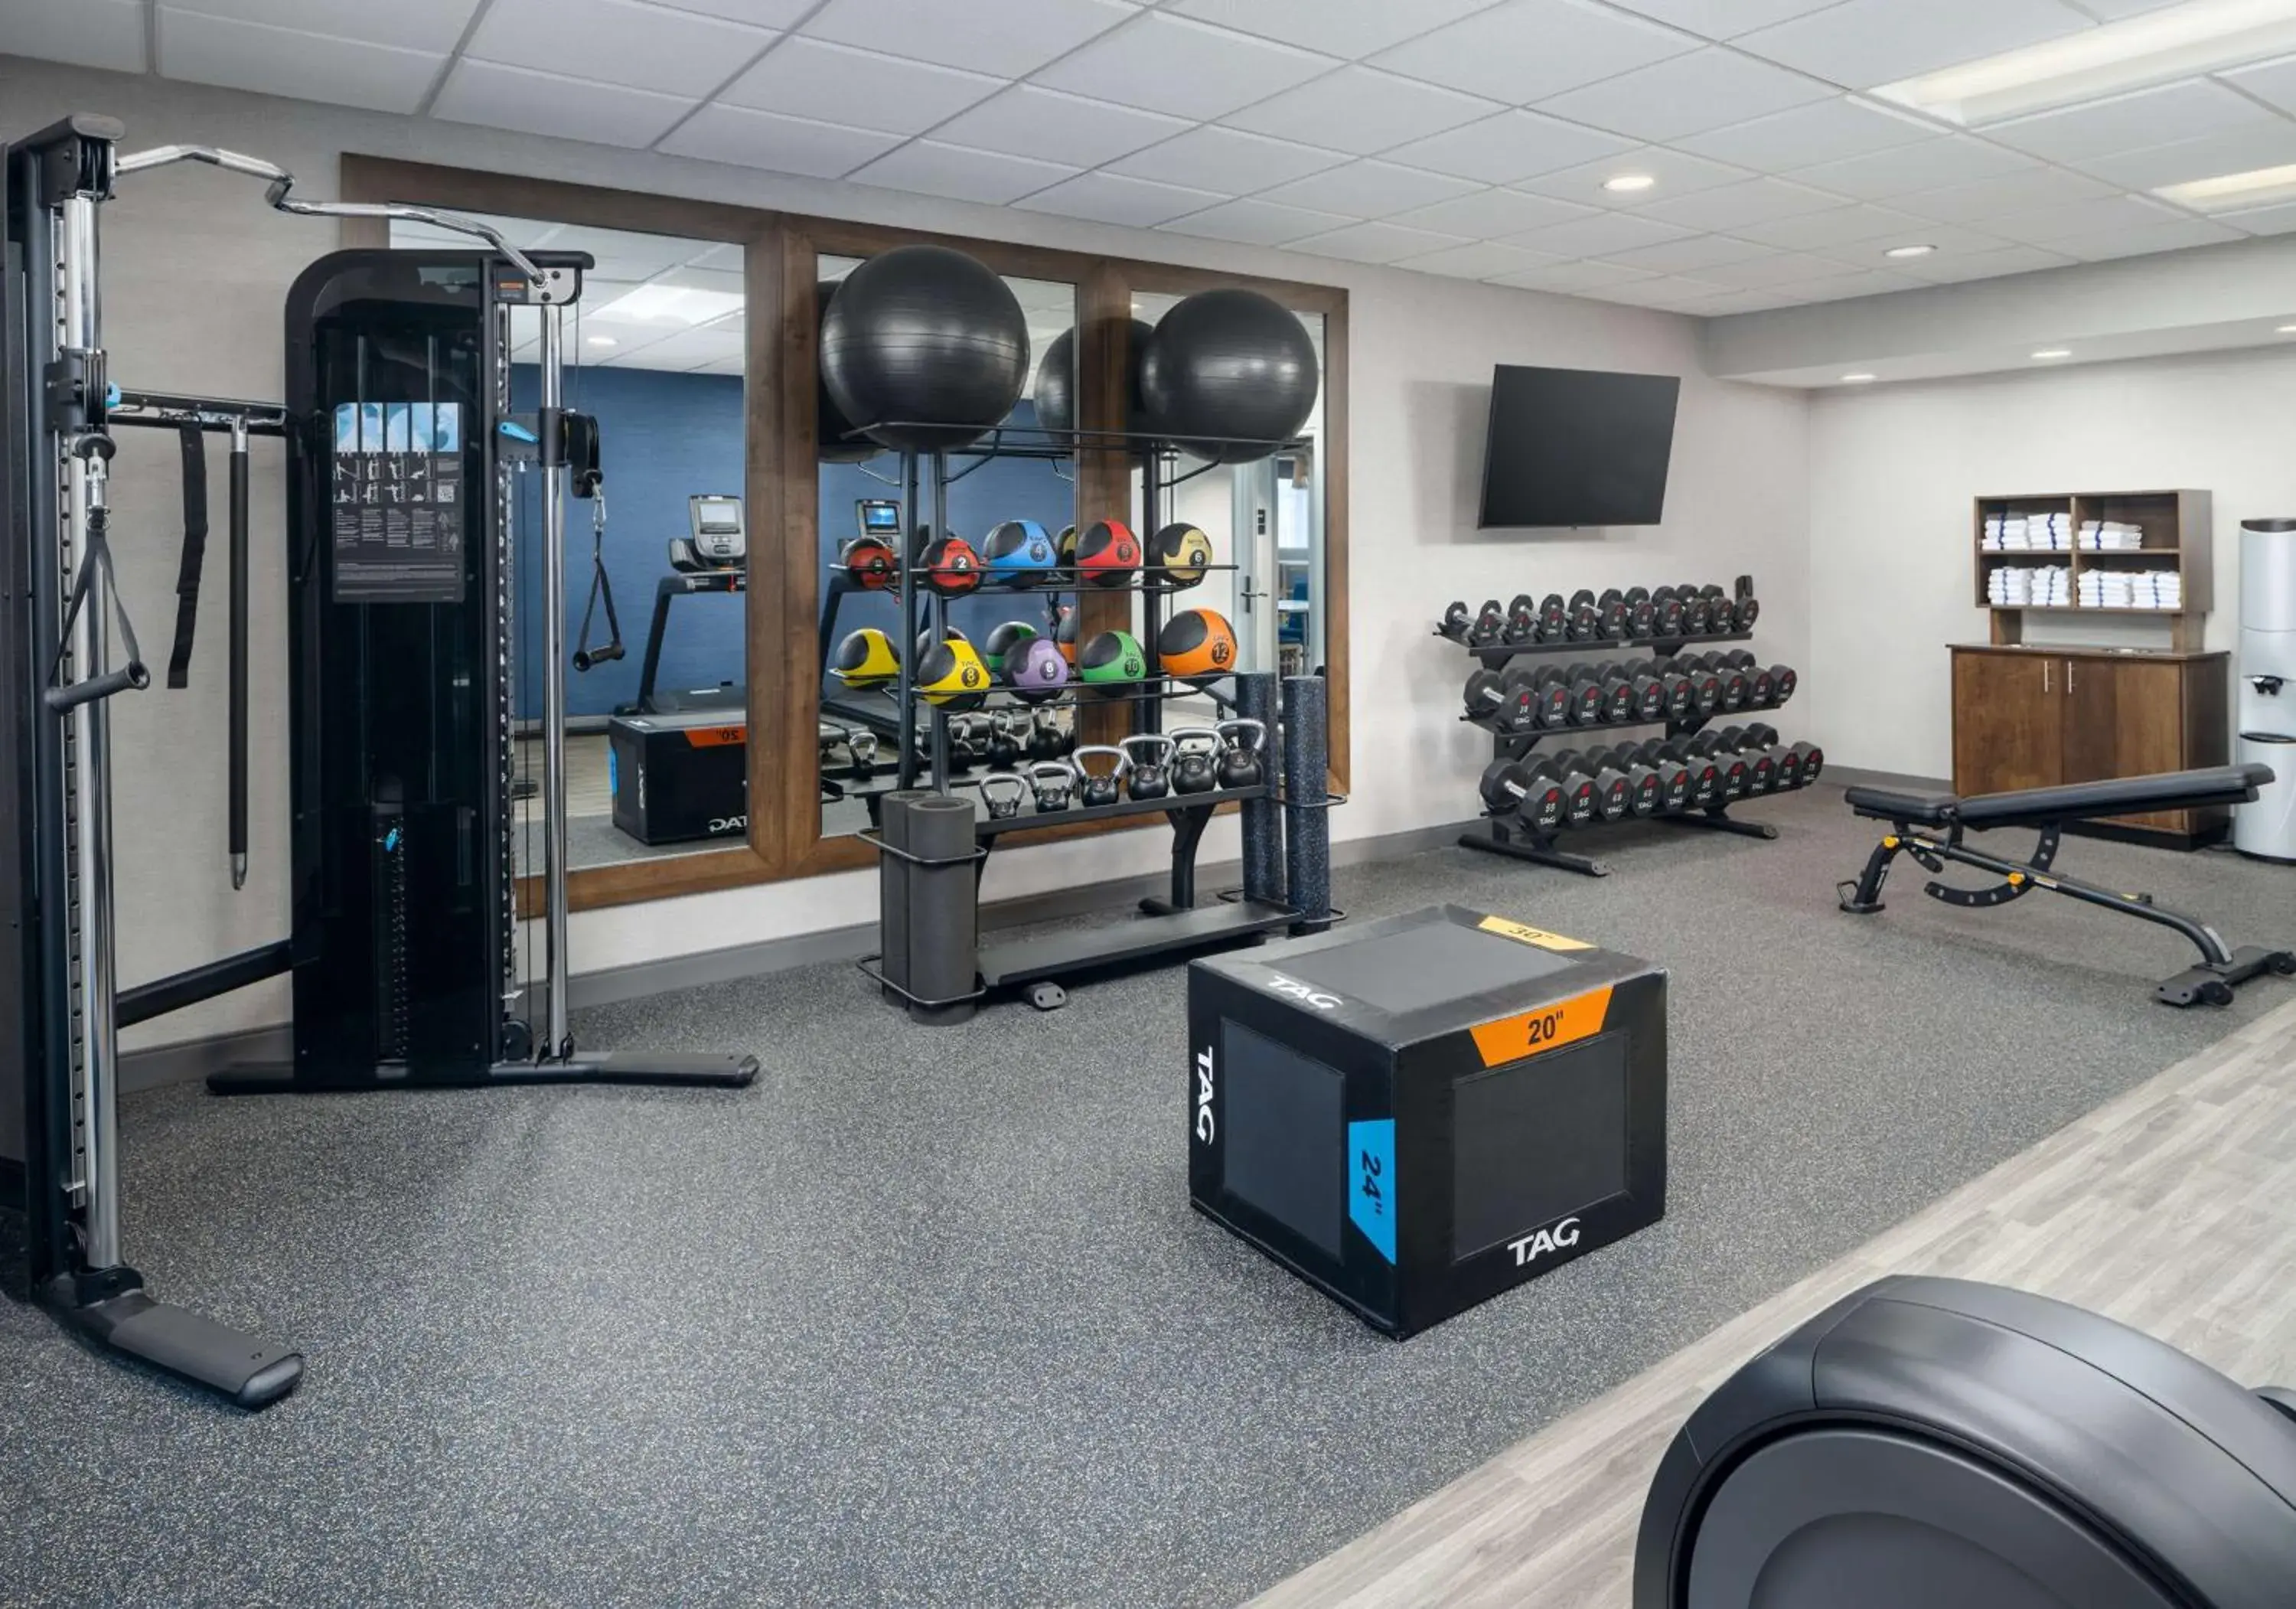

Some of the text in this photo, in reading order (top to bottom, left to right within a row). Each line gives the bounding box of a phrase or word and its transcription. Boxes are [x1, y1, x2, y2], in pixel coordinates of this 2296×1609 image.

[957, 558, 967, 570] 2
[1195, 552, 1202, 563] 6
[967, 668, 974, 681] 8
[1045, 661, 1054, 673] 8
[1267, 974, 1343, 1009] TAG
[1527, 1010, 1565, 1046] 20"
[1196, 1045, 1215, 1145] TAG
[1361, 1150, 1382, 1216] 24"
[1507, 1217, 1581, 1267] TAG
